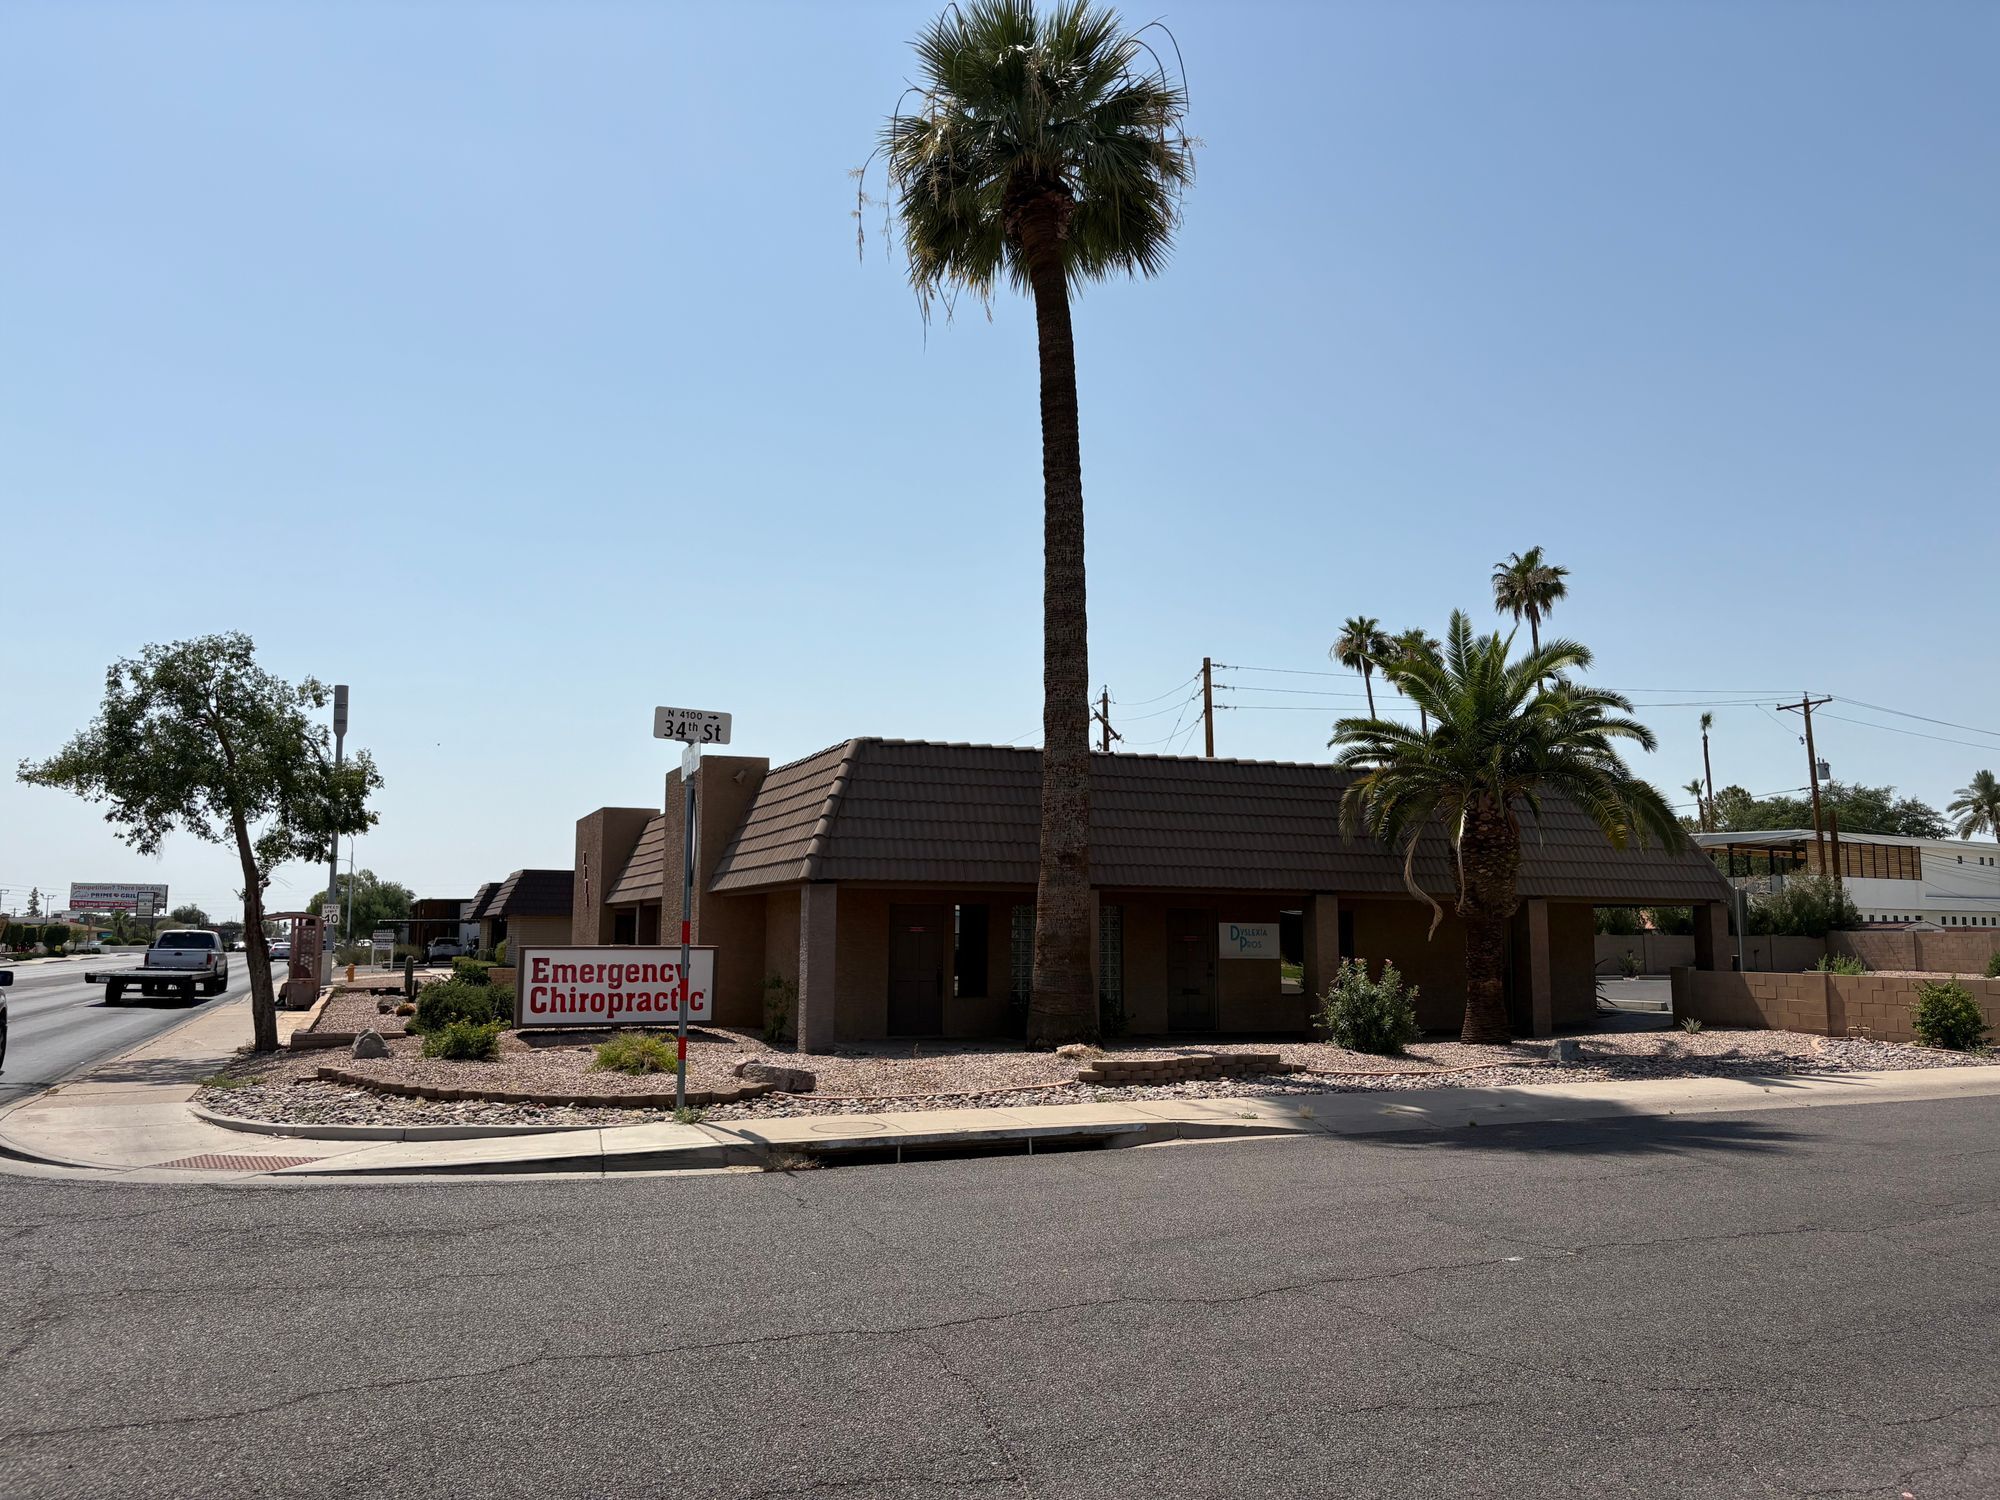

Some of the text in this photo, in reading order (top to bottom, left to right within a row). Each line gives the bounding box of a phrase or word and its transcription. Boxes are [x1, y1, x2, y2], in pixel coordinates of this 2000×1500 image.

[667, 709, 703, 720] N 4100
[664, 720, 721, 741] 34th St
[323, 914, 339, 923] 40
[1230, 925, 1268, 941] DYSLEXIA
[1240, 936, 1262, 952] PROS
[530, 984, 704, 1019] Chiropractc
